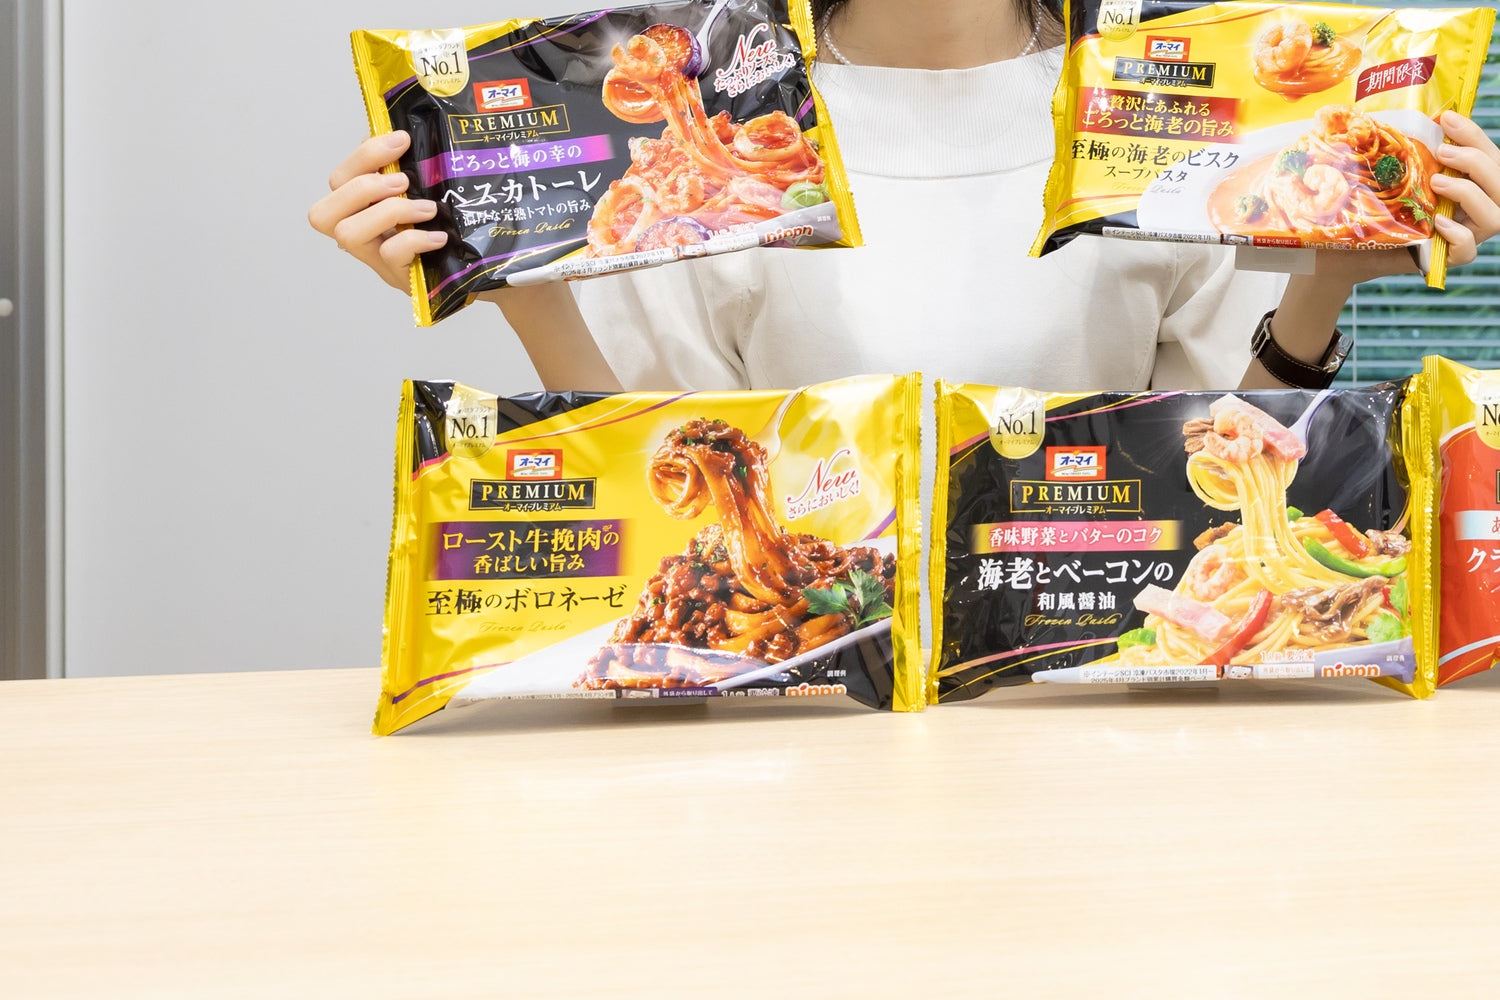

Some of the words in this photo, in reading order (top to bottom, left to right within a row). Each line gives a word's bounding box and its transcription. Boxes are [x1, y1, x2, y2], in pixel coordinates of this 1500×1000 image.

[1103, 7, 1134, 25] No.1
[717, 23, 776, 77] New
[1155, 42, 1181, 51] オーマイ
[420, 52, 463, 77] No.1
[1123, 62, 1206, 80] PREMIUM
[1359, 60, 1427, 93] 期間限定
[487, 87, 518, 99] オーマイ
[459, 109, 559, 135] PREMIUM
[1082, 110, 1234, 137] ごろっと海老の旨み
[1071, 138, 1240, 169] 至極の海老のビスク
[441, 170, 602, 204] ペスカトーレ
[488, 224, 530, 238] Frozen
[534, 218, 575, 235] Pasta
[451, 415, 489, 439] No.1
[996, 410, 1038, 435] No.1
[519, 457, 552, 467] オーマイ
[1060, 455, 1094, 466] オーマイ
[787, 449, 856, 504] New
[481, 483, 586, 501] PREMIUM
[788, 480, 859, 519] さらにおいしく!
[1021, 485, 1131, 504] PREMIUM
[442, 526, 620, 553] ロースト牛挽肉の
[990, 526, 1163, 547] 香味野菜とバターのコク
[473, 553, 585, 574] 香ばしい旨み
[977, 556, 1175, 590] 海老とベーコンの
[425, 584, 628, 616] 至極のボロネーゼ
[1024, 613, 1072, 627] Frozen
[1075, 612, 1123, 627] Pasta
